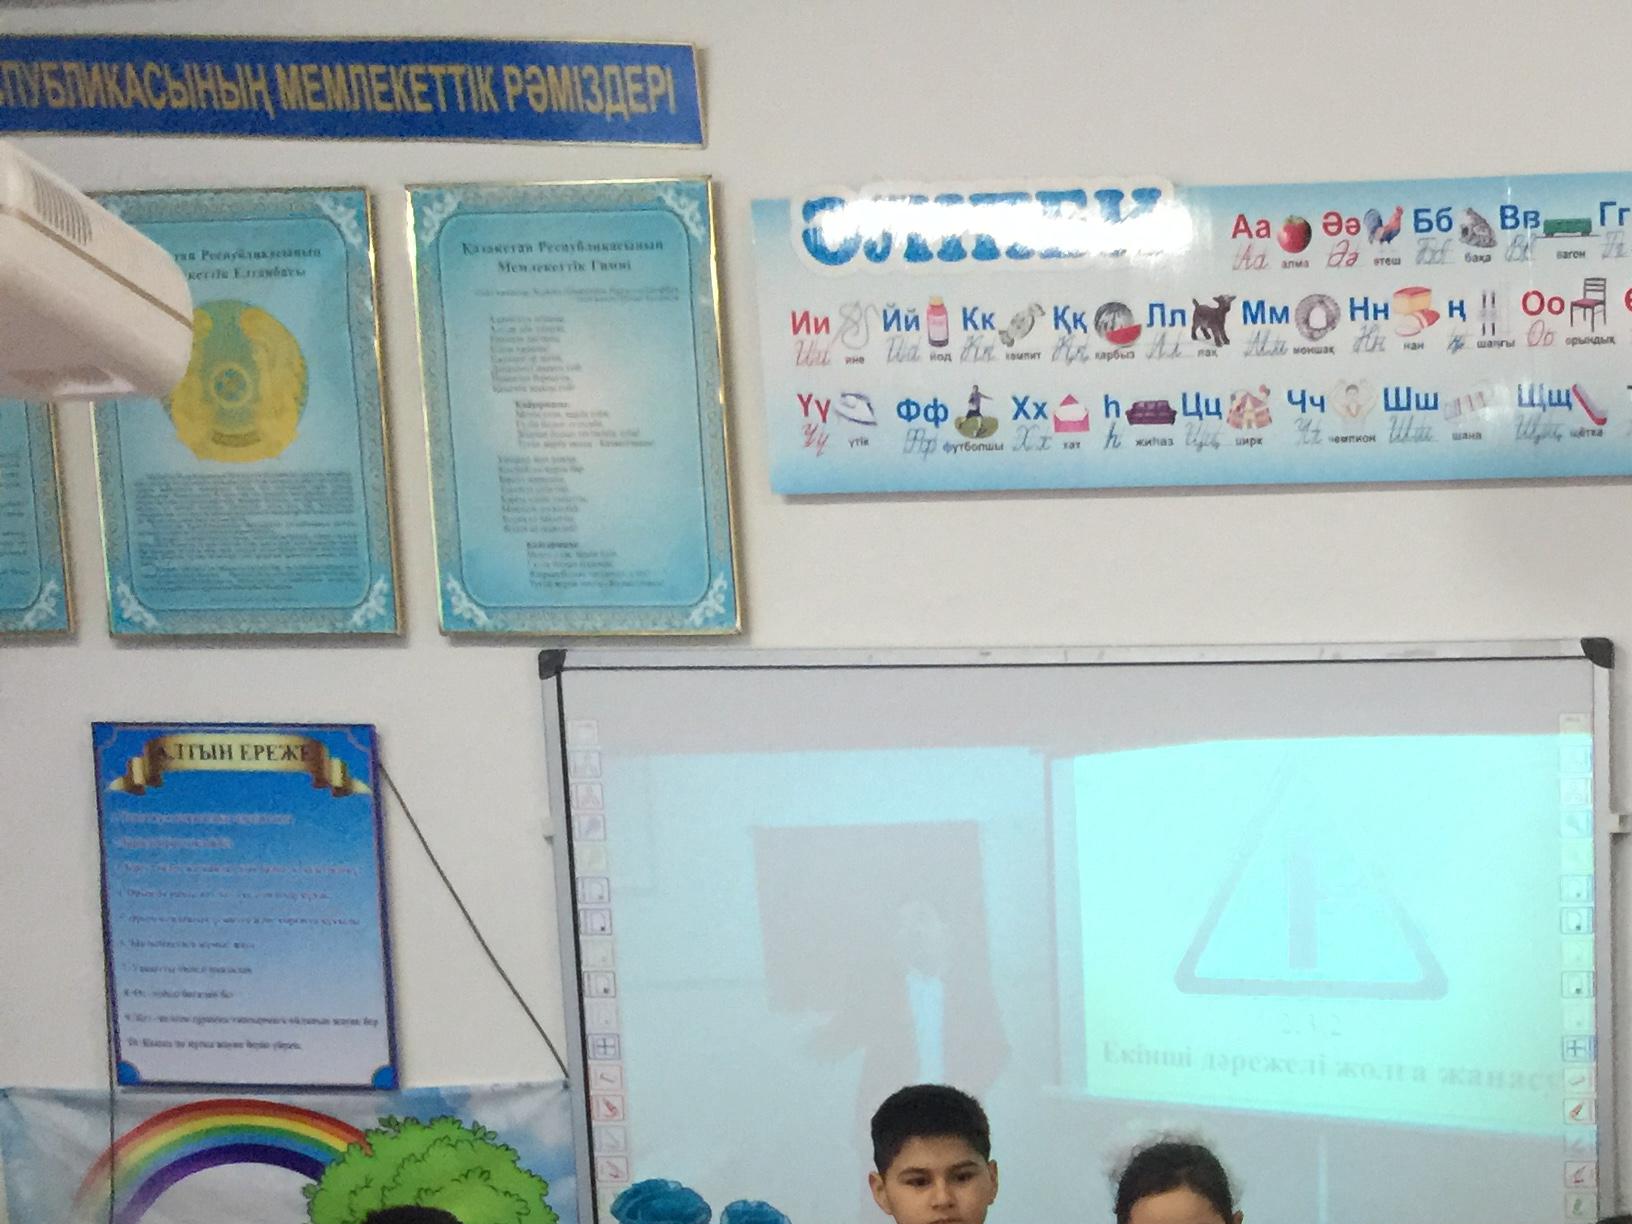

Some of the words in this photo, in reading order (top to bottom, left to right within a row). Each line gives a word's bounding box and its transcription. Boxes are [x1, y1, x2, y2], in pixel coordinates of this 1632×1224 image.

[0, 61, 276, 120] ПУБЛИКАСЫНЫҢ
[276, 63, 500, 113] МЕМЛЕКЕТТІК
[504, 64, 677, 122] РӘМІЗДЕРІ
[1232, 213, 1271, 239] Аа
[1322, 211, 1361, 237] Әә
[1413, 206, 1453, 233] Бб
[1500, 204, 1540, 231] Вв
[1599, 201, 1630, 227] Гг
[791, 309, 831, 336] Ии
[882, 303, 921, 333] Йй
[962, 305, 997, 332] Кк
[1146, 302, 1187, 329] Лл
[1242, 299, 1290, 326] Мм
[1349, 295, 1390, 322] Нн
[1522, 289, 1566, 317] Оо
[896, 397, 949, 429] Фф
[1011, 395, 1050, 421] Хх
[1181, 391, 1224, 422] Цц
[1287, 388, 1327, 414] Чч
[1383, 386, 1439, 413] Шш
[1517, 383, 1574, 413] Щщ
